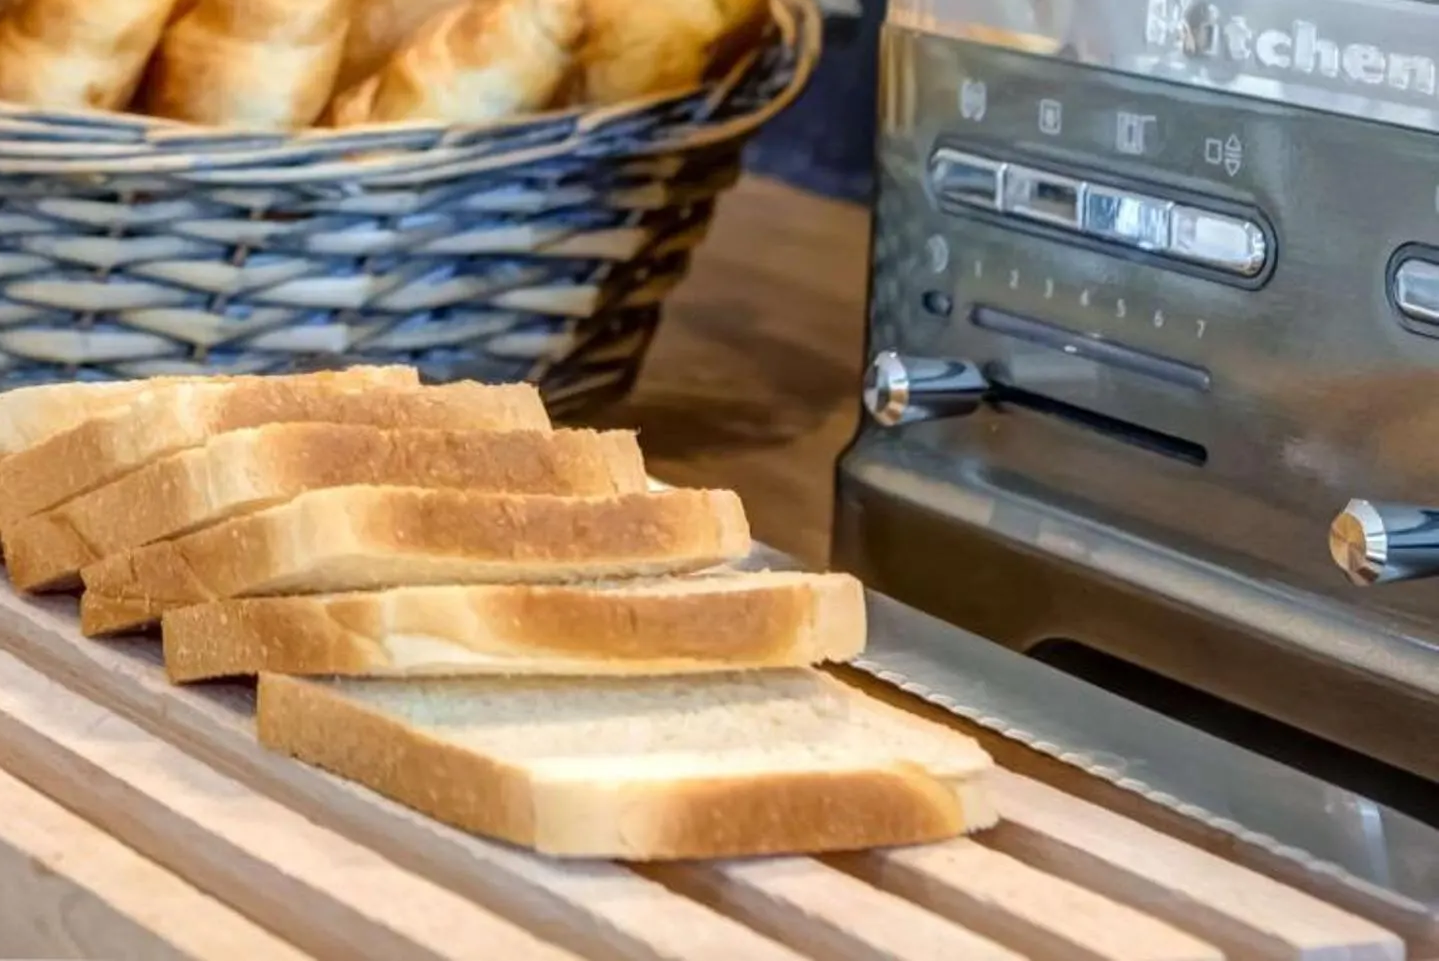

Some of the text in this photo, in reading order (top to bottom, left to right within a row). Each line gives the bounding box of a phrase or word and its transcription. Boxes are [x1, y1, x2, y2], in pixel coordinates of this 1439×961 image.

[1008, 268, 1020, 289] 2
[1078, 287, 1091, 308] 4
[1115, 297, 1127, 319] 5
[1152, 307, 1164, 328] 6
[1195, 318, 1207, 339] 7
